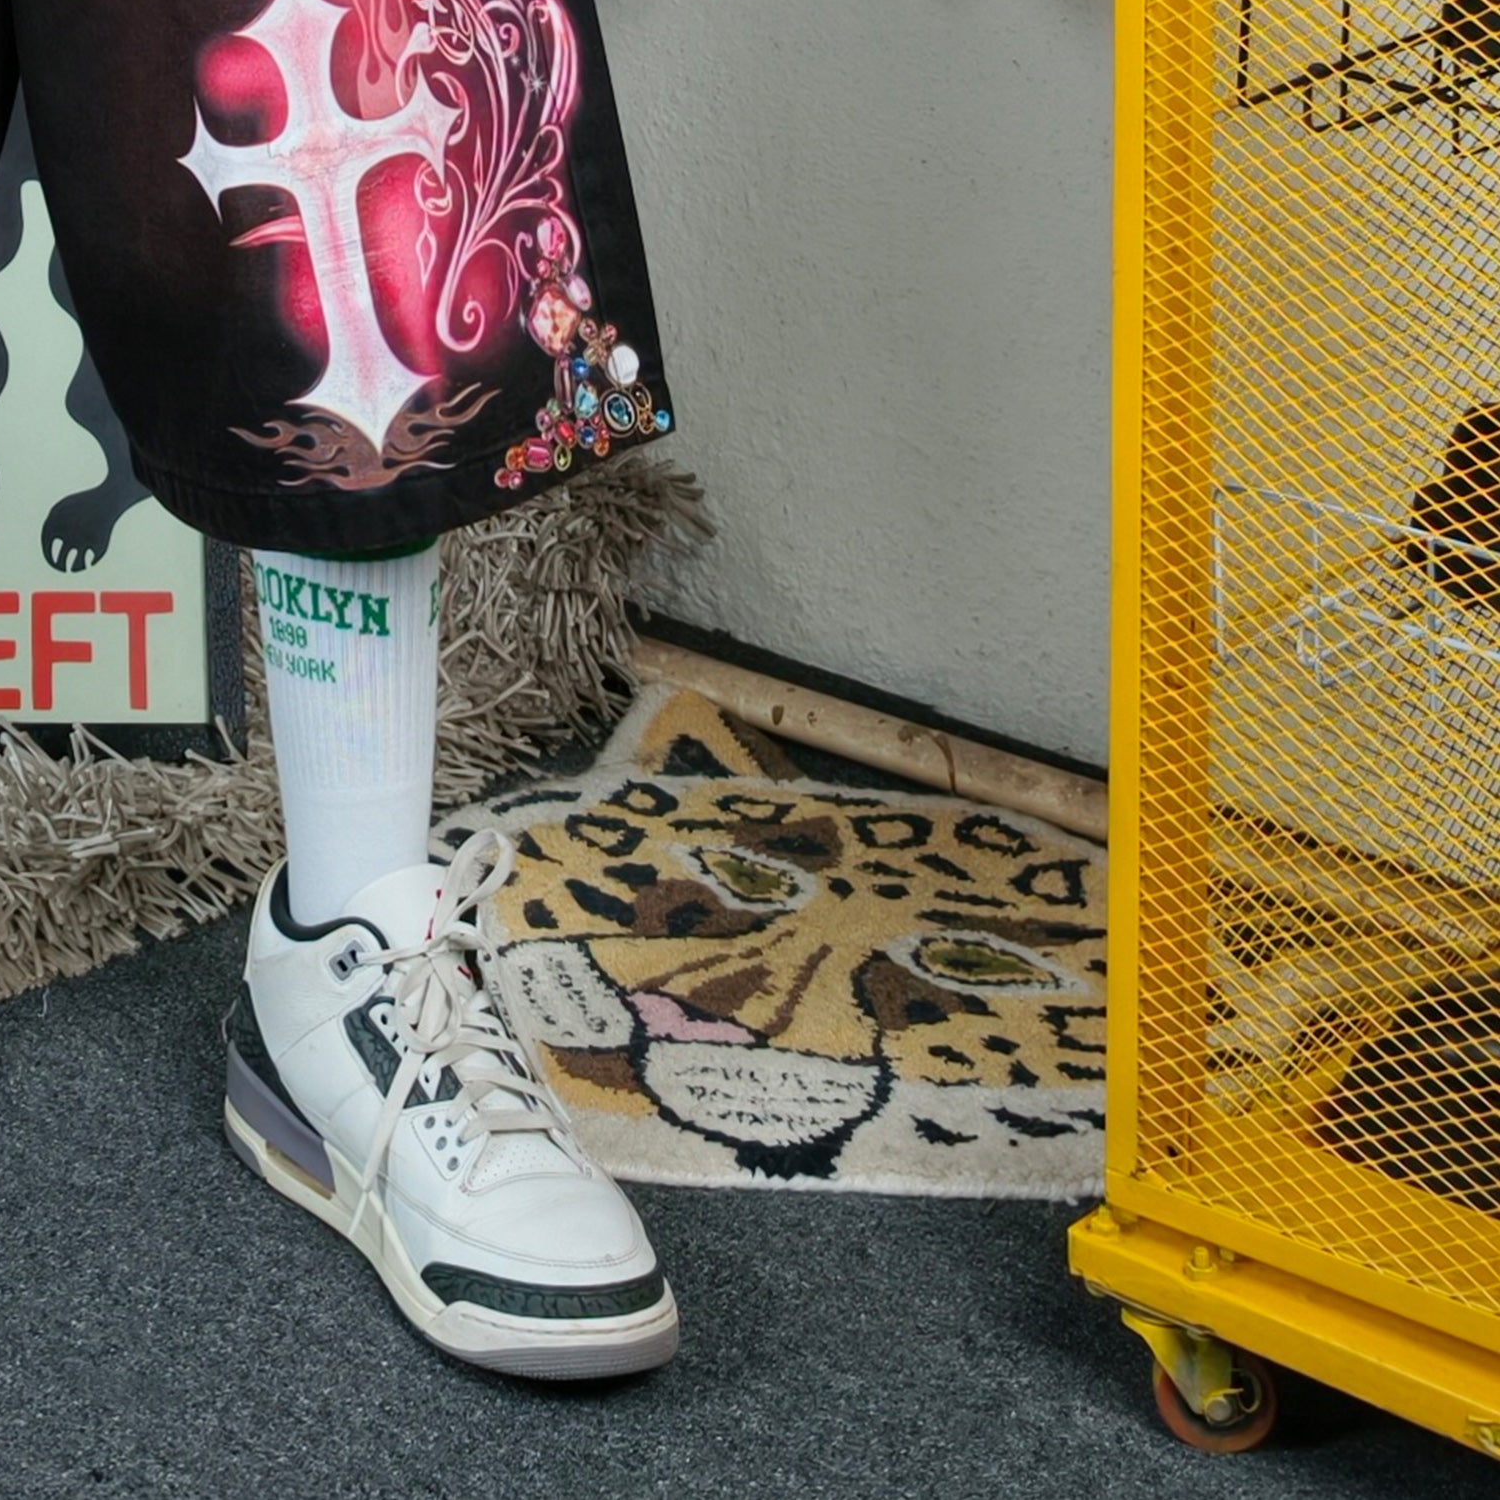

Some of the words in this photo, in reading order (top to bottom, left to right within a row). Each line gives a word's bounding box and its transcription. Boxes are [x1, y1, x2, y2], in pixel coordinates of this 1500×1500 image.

[254, 561, 391, 637] OOKLYN
[269, 616, 308, 649] 1898
[286, 654, 336, 684] YORK
